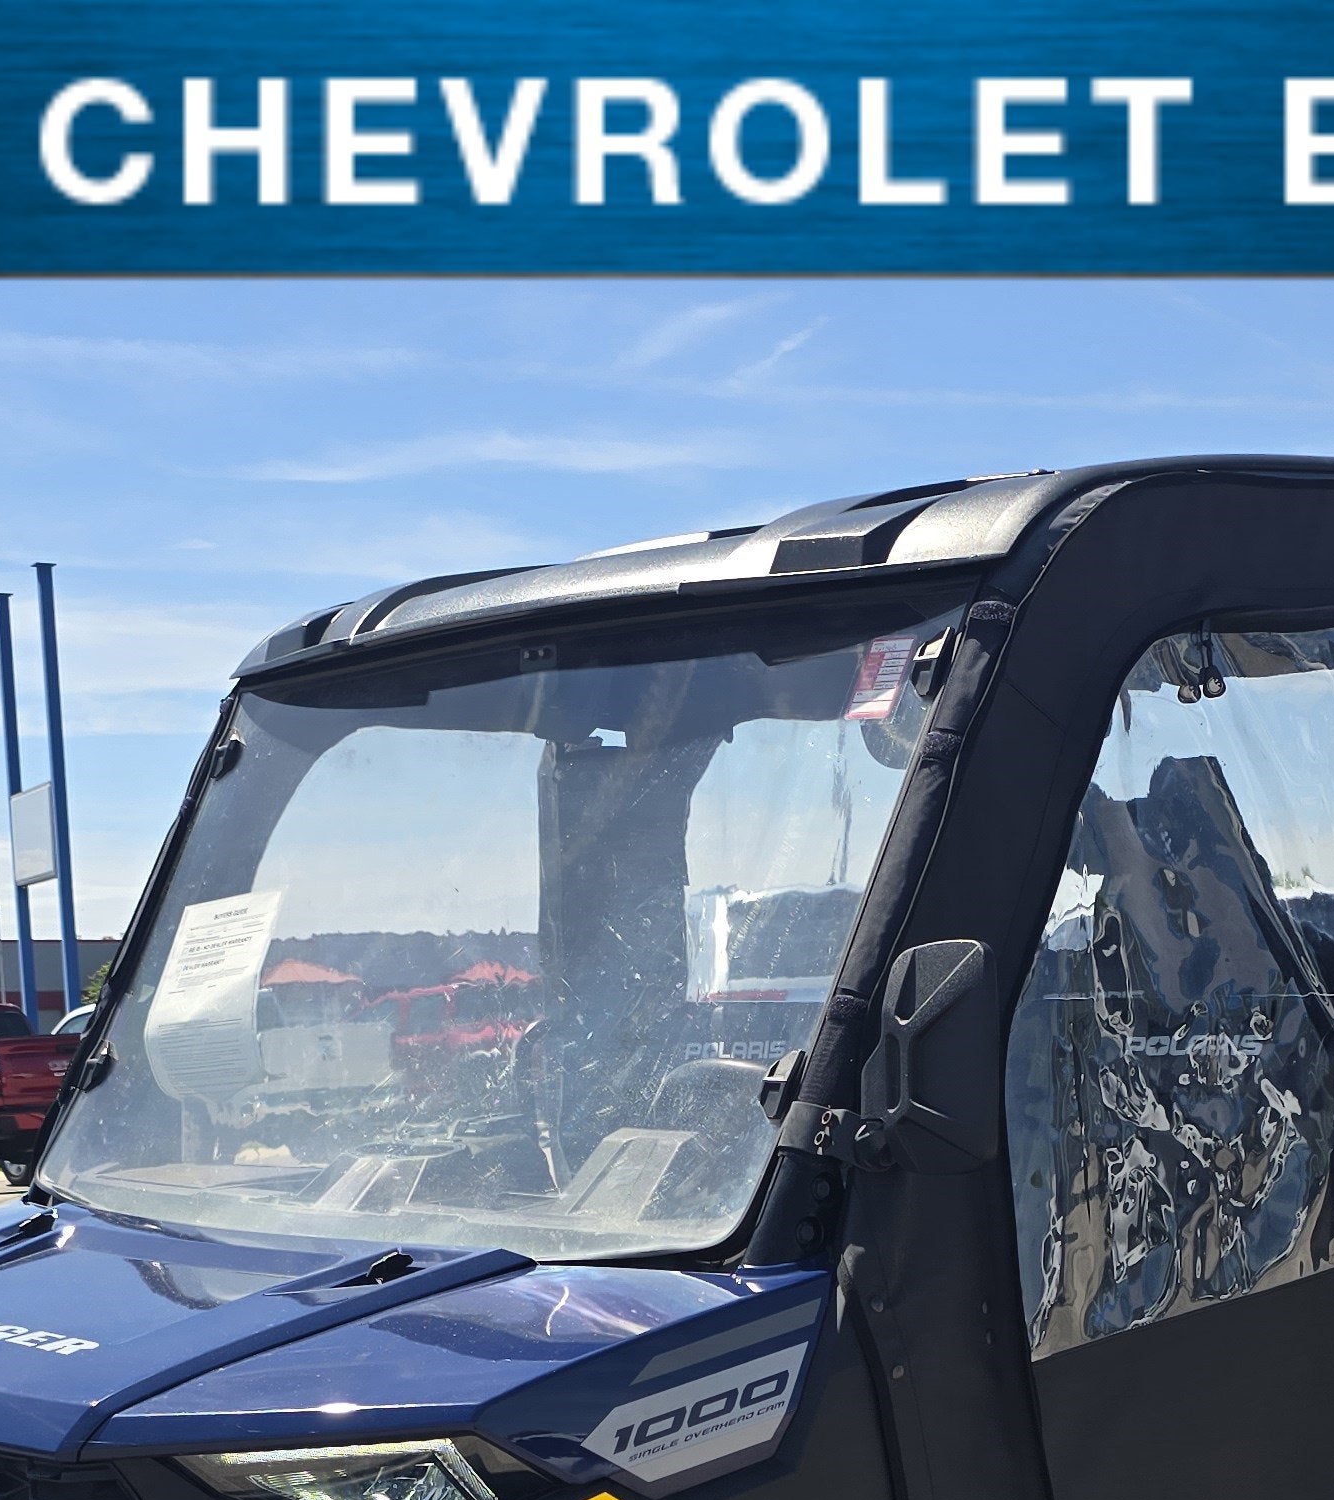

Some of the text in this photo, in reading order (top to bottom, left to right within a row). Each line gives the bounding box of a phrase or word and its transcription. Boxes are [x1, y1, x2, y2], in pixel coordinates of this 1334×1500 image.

[685, 1041, 787, 1060] POLARIS
[613, 1369, 790, 1455] 1000
[628, 1400, 786, 1463] SINGLE OVERHEAD CAM
